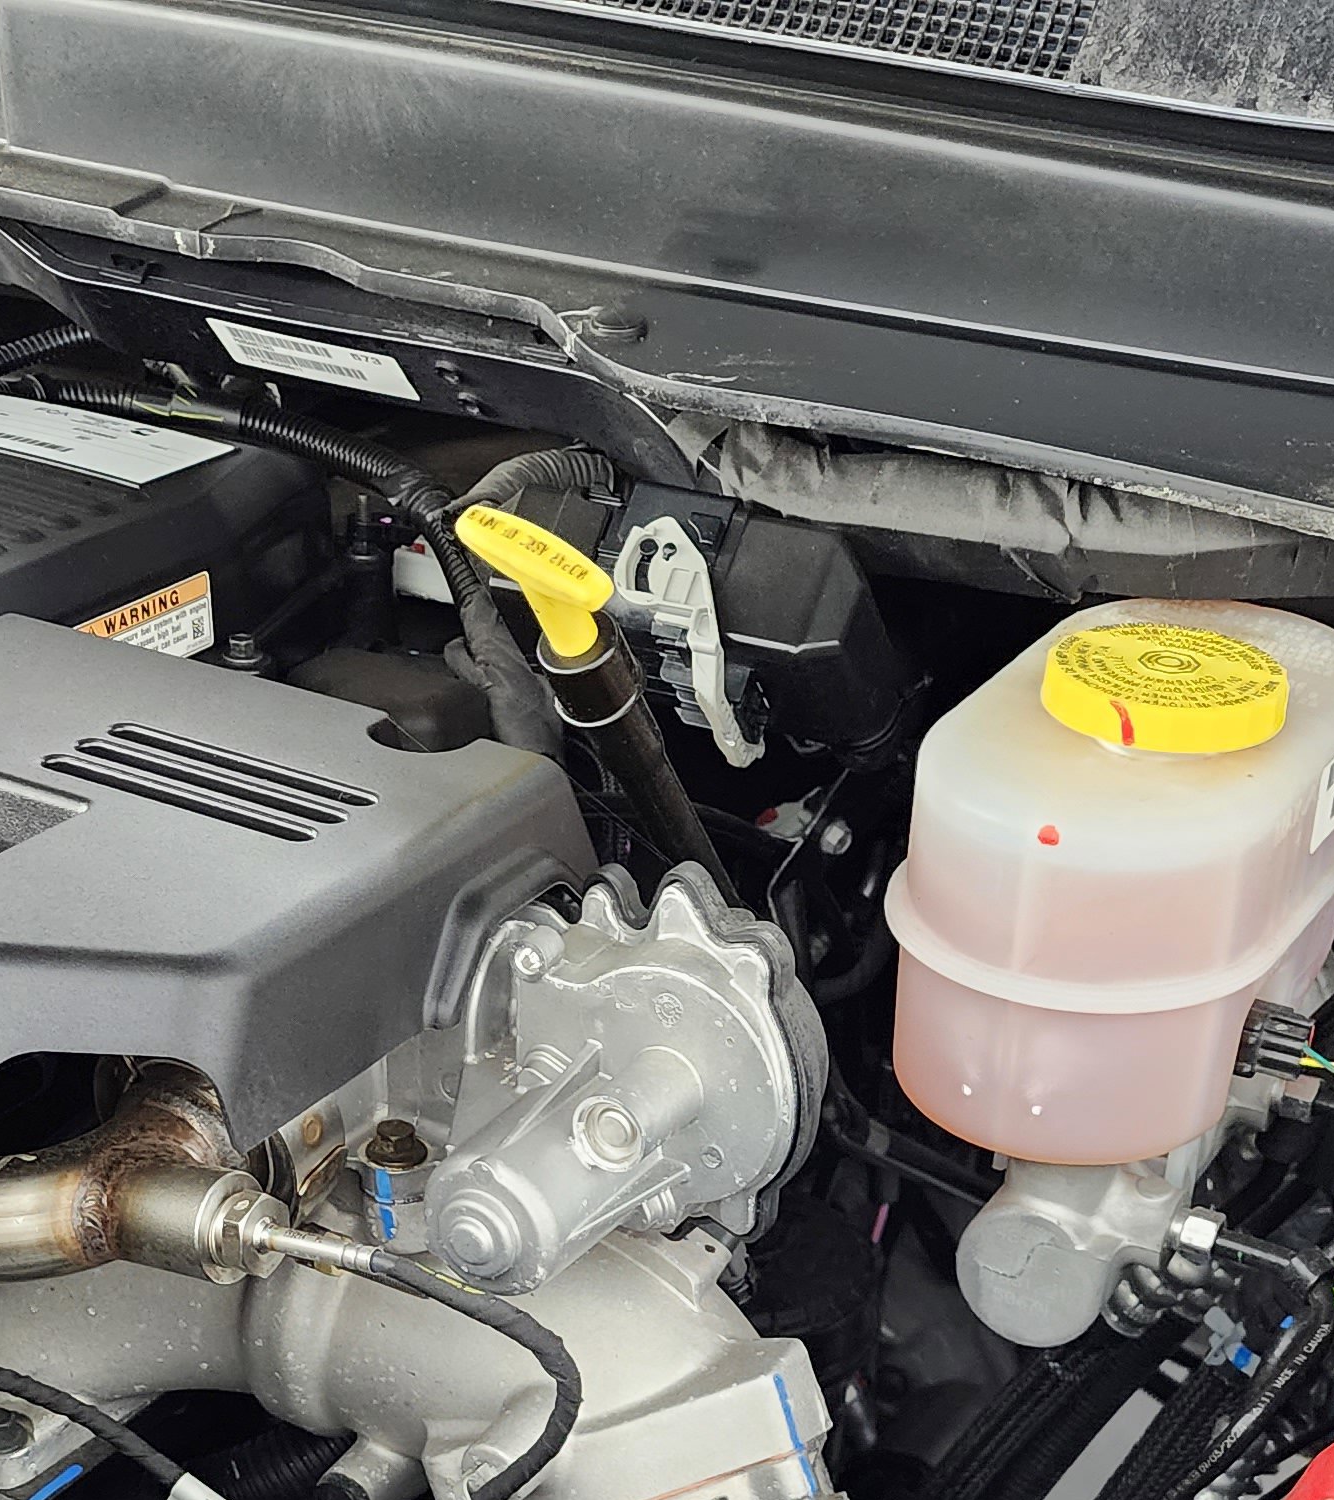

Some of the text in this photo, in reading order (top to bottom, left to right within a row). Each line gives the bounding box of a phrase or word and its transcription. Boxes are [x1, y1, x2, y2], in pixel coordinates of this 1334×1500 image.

[104, 590, 180, 634] WARNING
[1273, 1369, 1295, 1389] MADE
[1293, 1354, 1308, 1366] IN
